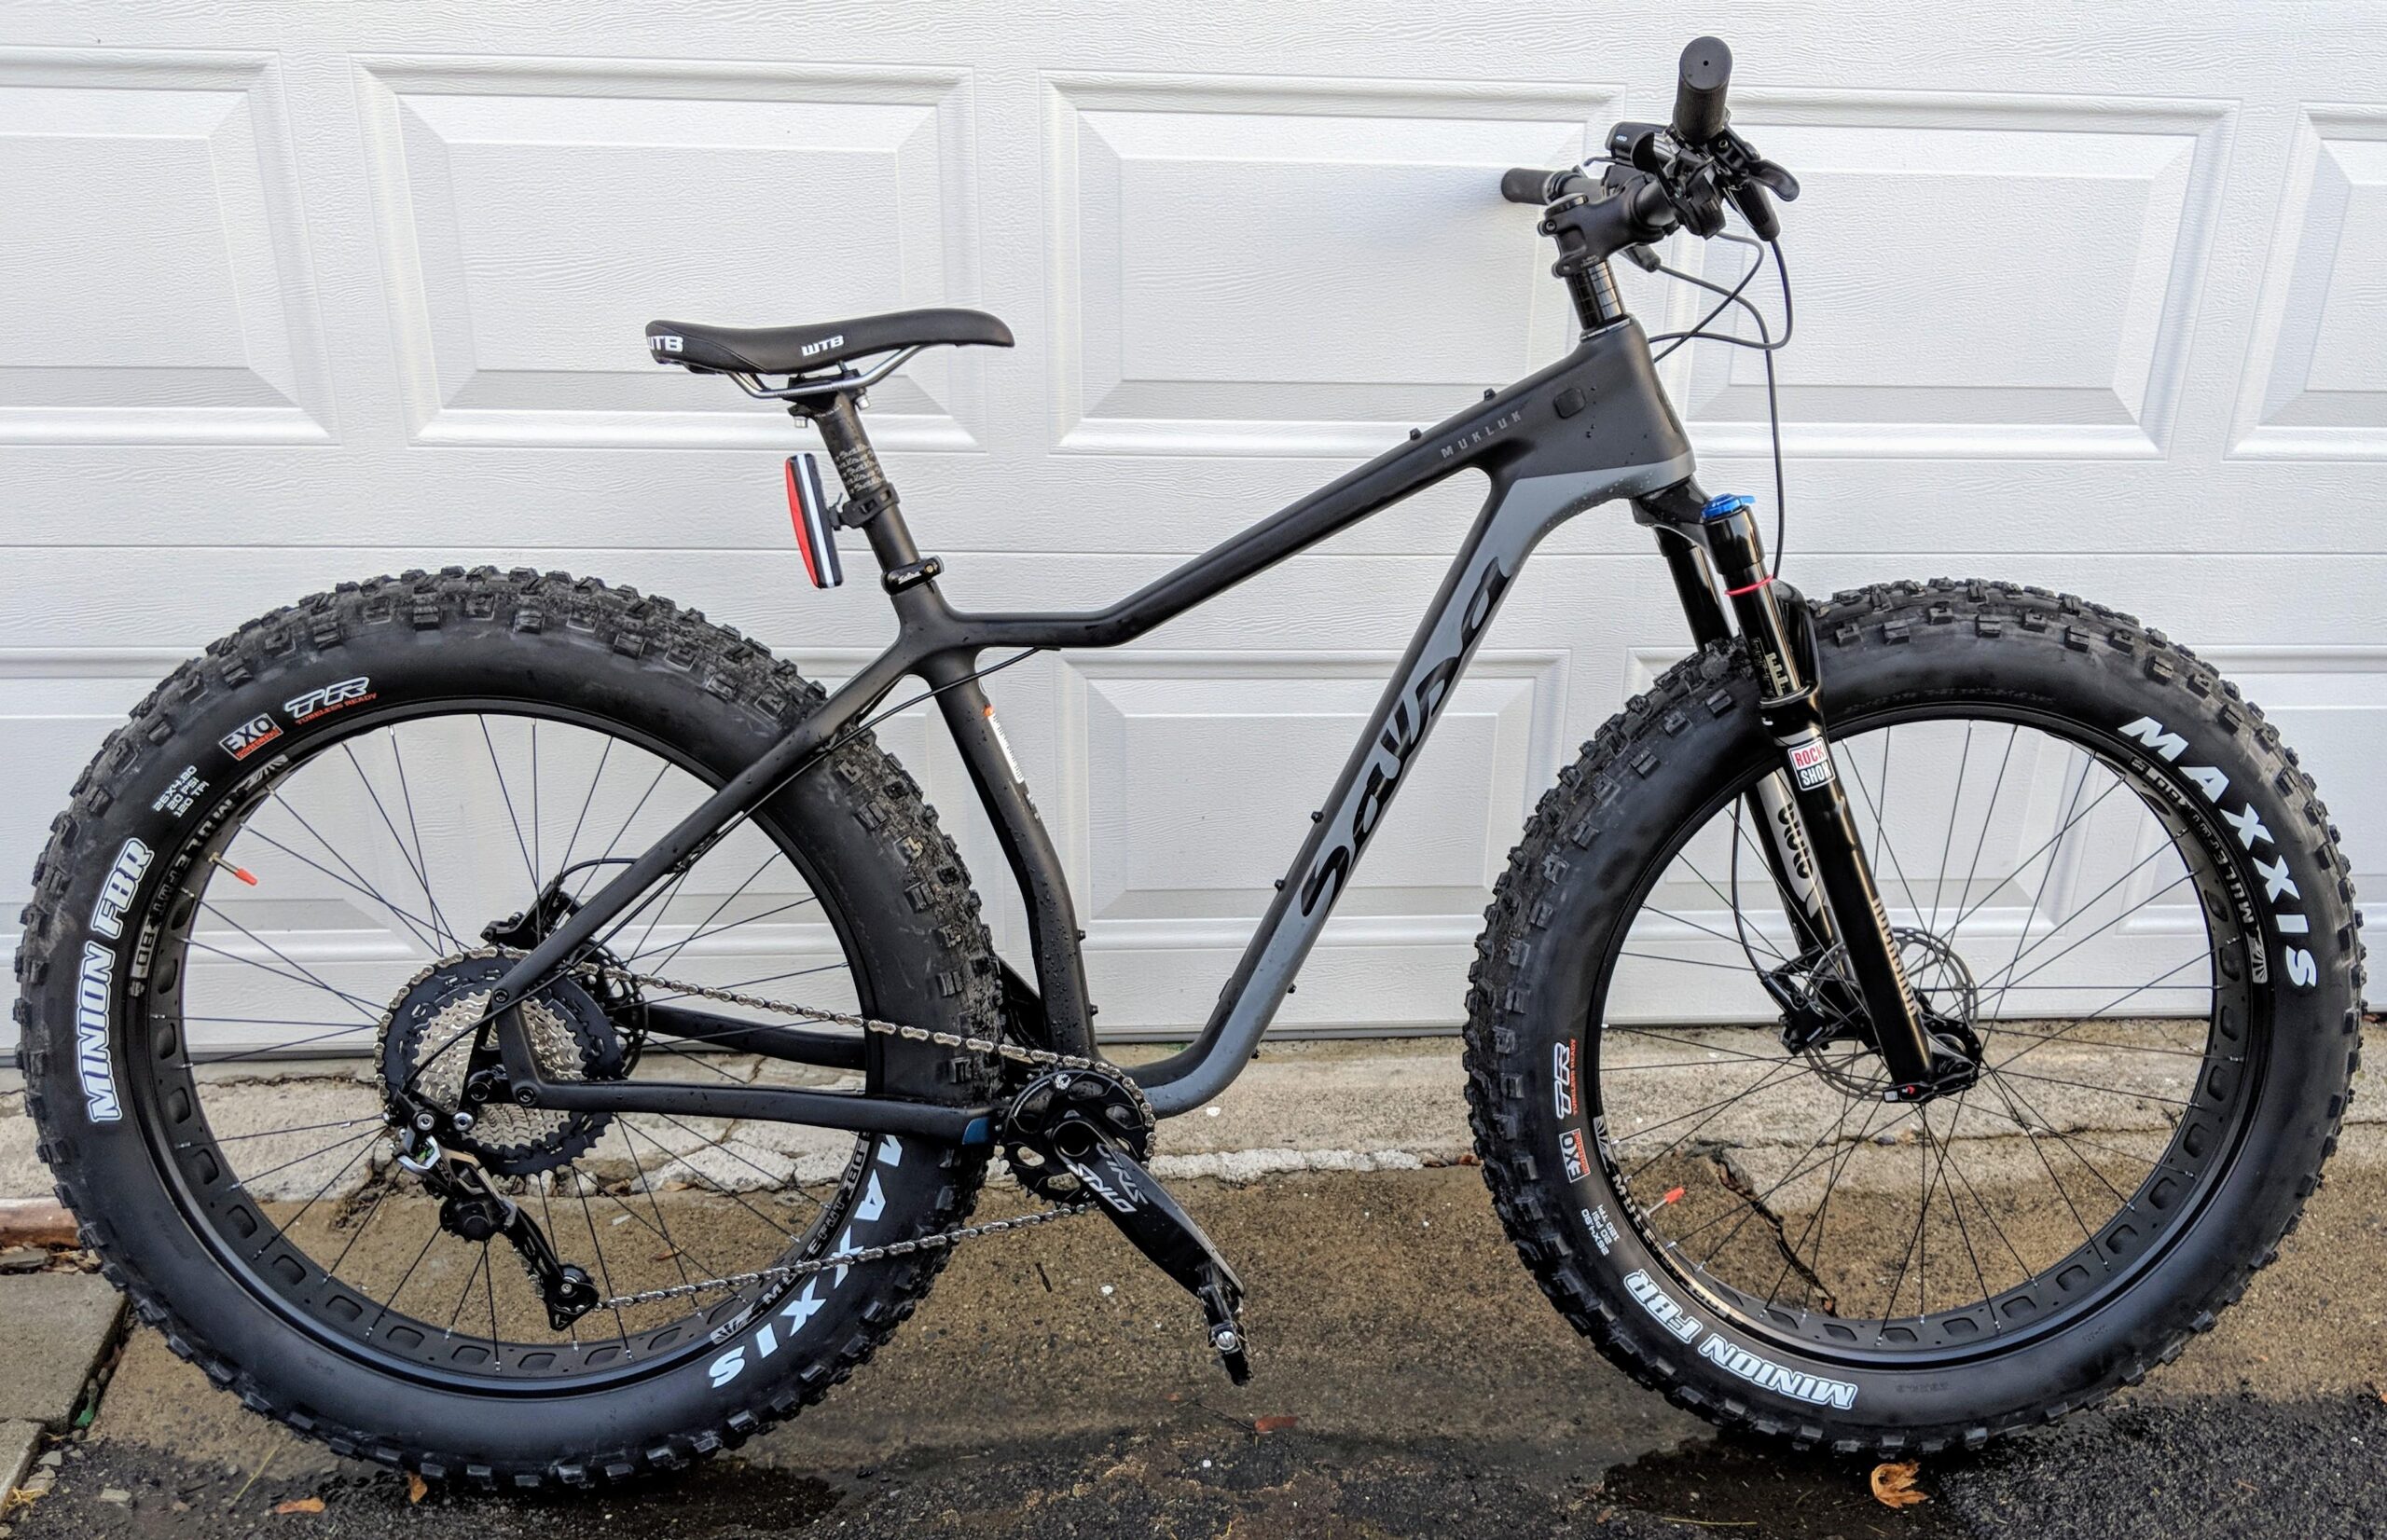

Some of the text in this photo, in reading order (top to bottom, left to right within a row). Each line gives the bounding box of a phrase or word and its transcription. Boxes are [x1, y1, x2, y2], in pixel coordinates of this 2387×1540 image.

[802, 335, 845, 356] WTB
[1441, 410, 1522, 459] MUKLUK
[283, 677, 370, 719] TR
[295, 693, 379, 725] TUBELESS READY
[224, 716, 275, 751] EXO
[1794, 746, 1826, 768] ROCK
[1801, 762, 1832, 787] SHOX
[153, 765, 198, 812] 26X4.80
[166, 777, 200, 811] 20 PSI
[172, 780, 210, 818] 120 TPI
[2118, 716, 2318, 988] MAXXIS
[76, 836, 156, 1123] MINION FBR
[1553, 1041, 1572, 1120] TR
[1569, 1038, 1579, 1116] TUBELESS READY
[1561, 1132, 1582, 1180] EXO
[1581, 1208, 1610, 1256] 26X4.80
[1591, 1210, 1612, 1245] 20 PSI
[1596, 1203, 1621, 1242] 120 TPI
[1623, 1269, 1859, 1410] MINION FBR
